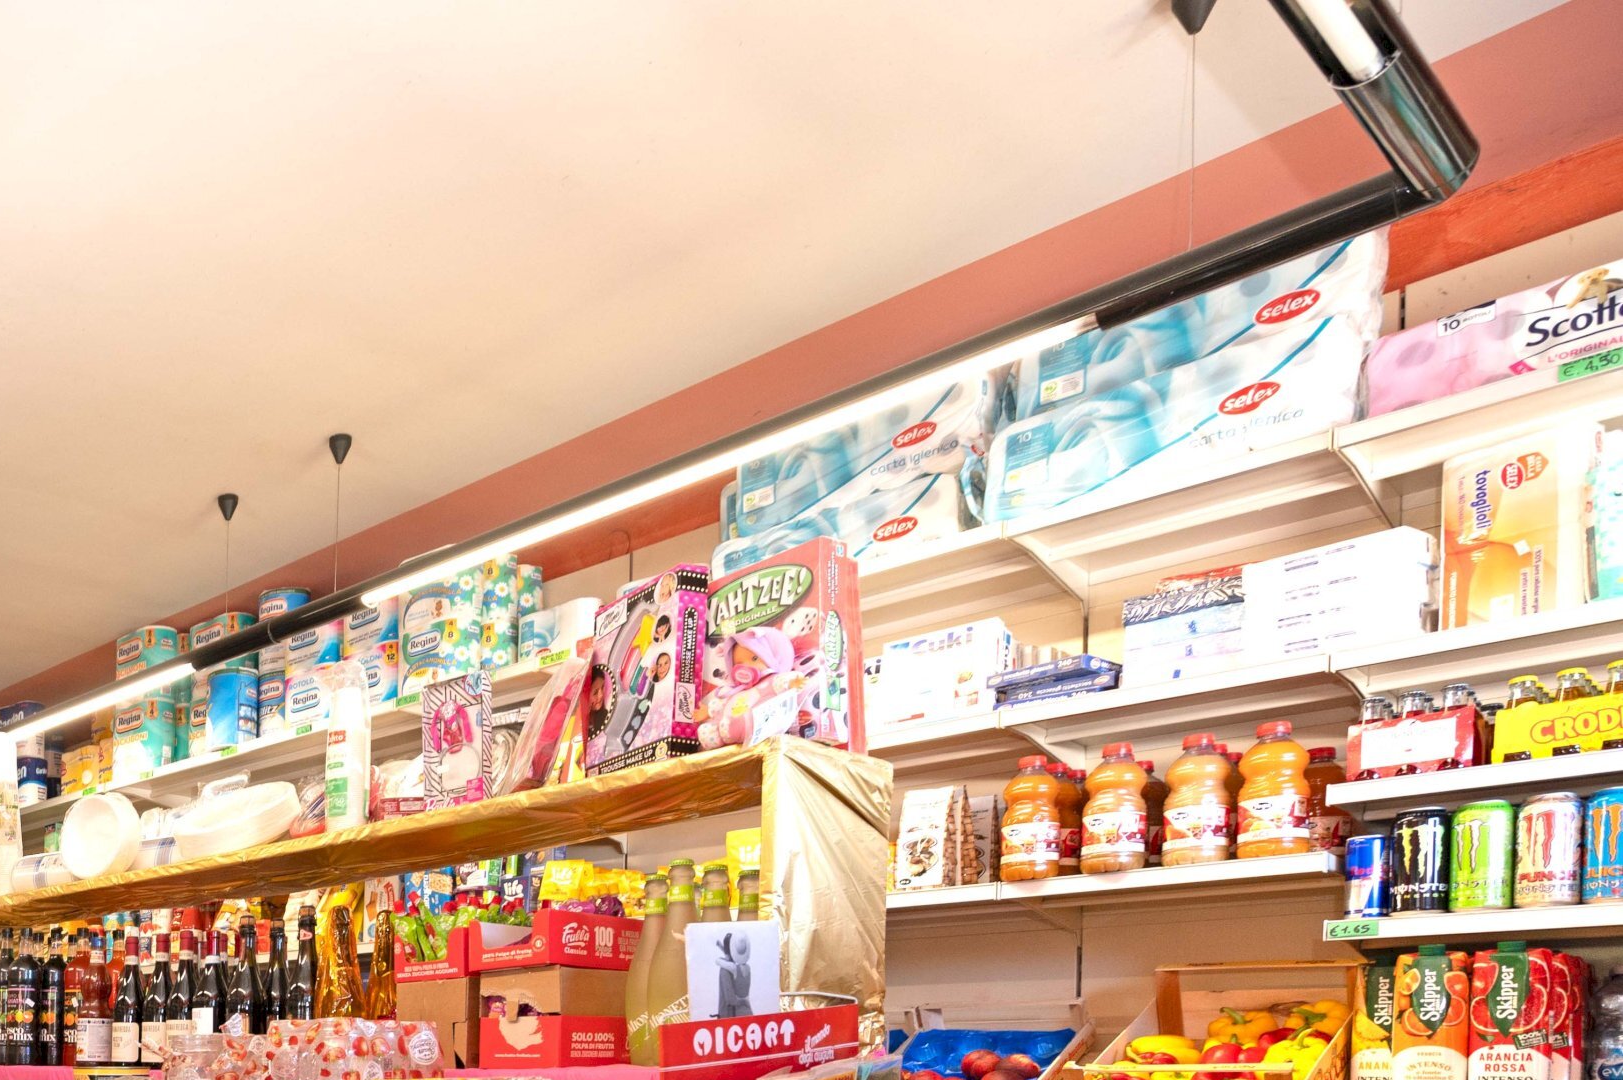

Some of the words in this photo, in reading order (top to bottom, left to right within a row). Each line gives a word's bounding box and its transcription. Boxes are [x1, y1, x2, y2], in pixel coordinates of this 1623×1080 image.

[1257, 291, 1319, 324] selex
[1443, 318, 1461, 333] 10
[1584, 353, 1621, 371] 4,50
[1223, 383, 1281, 413] selex
[895, 422, 935, 447] selex
[1017, 431, 1032, 443] 10
[870, 457, 906, 477] carta
[908, 440, 959, 464] igienica
[1506, 464, 1518, 488] SELEX
[1470, 470, 1492, 530] tovaglioli
[876, 517, 917, 542] selex
[259, 602, 284, 617] Regina
[195, 628, 222, 646] Regina
[410, 633, 438, 650] Regina
[118, 643, 141, 659] Regina
[386, 652, 396, 661] 12
[683, 650, 692, 683] TROUSSE
[688, 617, 694, 630] UP
[1057, 659, 1072, 669] 240
[259, 683, 281, 699] egina
[292, 691, 318, 707] Regina
[118, 712, 142, 727] Regina
[600, 760, 626, 775] TROUSSE
[626, 753, 645, 767] MAKE
[644, 748, 654, 760] UP
[503, 880, 525, 898] life
[563, 946, 588, 956] Classico
[411, 970, 433, 978] ZUCCHERI
[433, 968, 459, 976] AGGIUNTI
[1373, 975, 1391, 1027] Skipper
[1420, 968, 1437, 1022] Skipper
[1496, 965, 1515, 1021] Skipper
[14, 1031, 34, 1042] mix
[571, 1032, 593, 1043] SOLO
[593, 1032, 615, 1042] 100%
[811, 1023, 831, 1045] mondo
[571, 1042, 590, 1051] POLPA
[595, 1042, 615, 1050] FRUTTA
[798, 1050, 814, 1068] degli
[1479, 1051, 1534, 1063] ARANCIA
[1484, 1062, 1527, 1074] ROSSA
